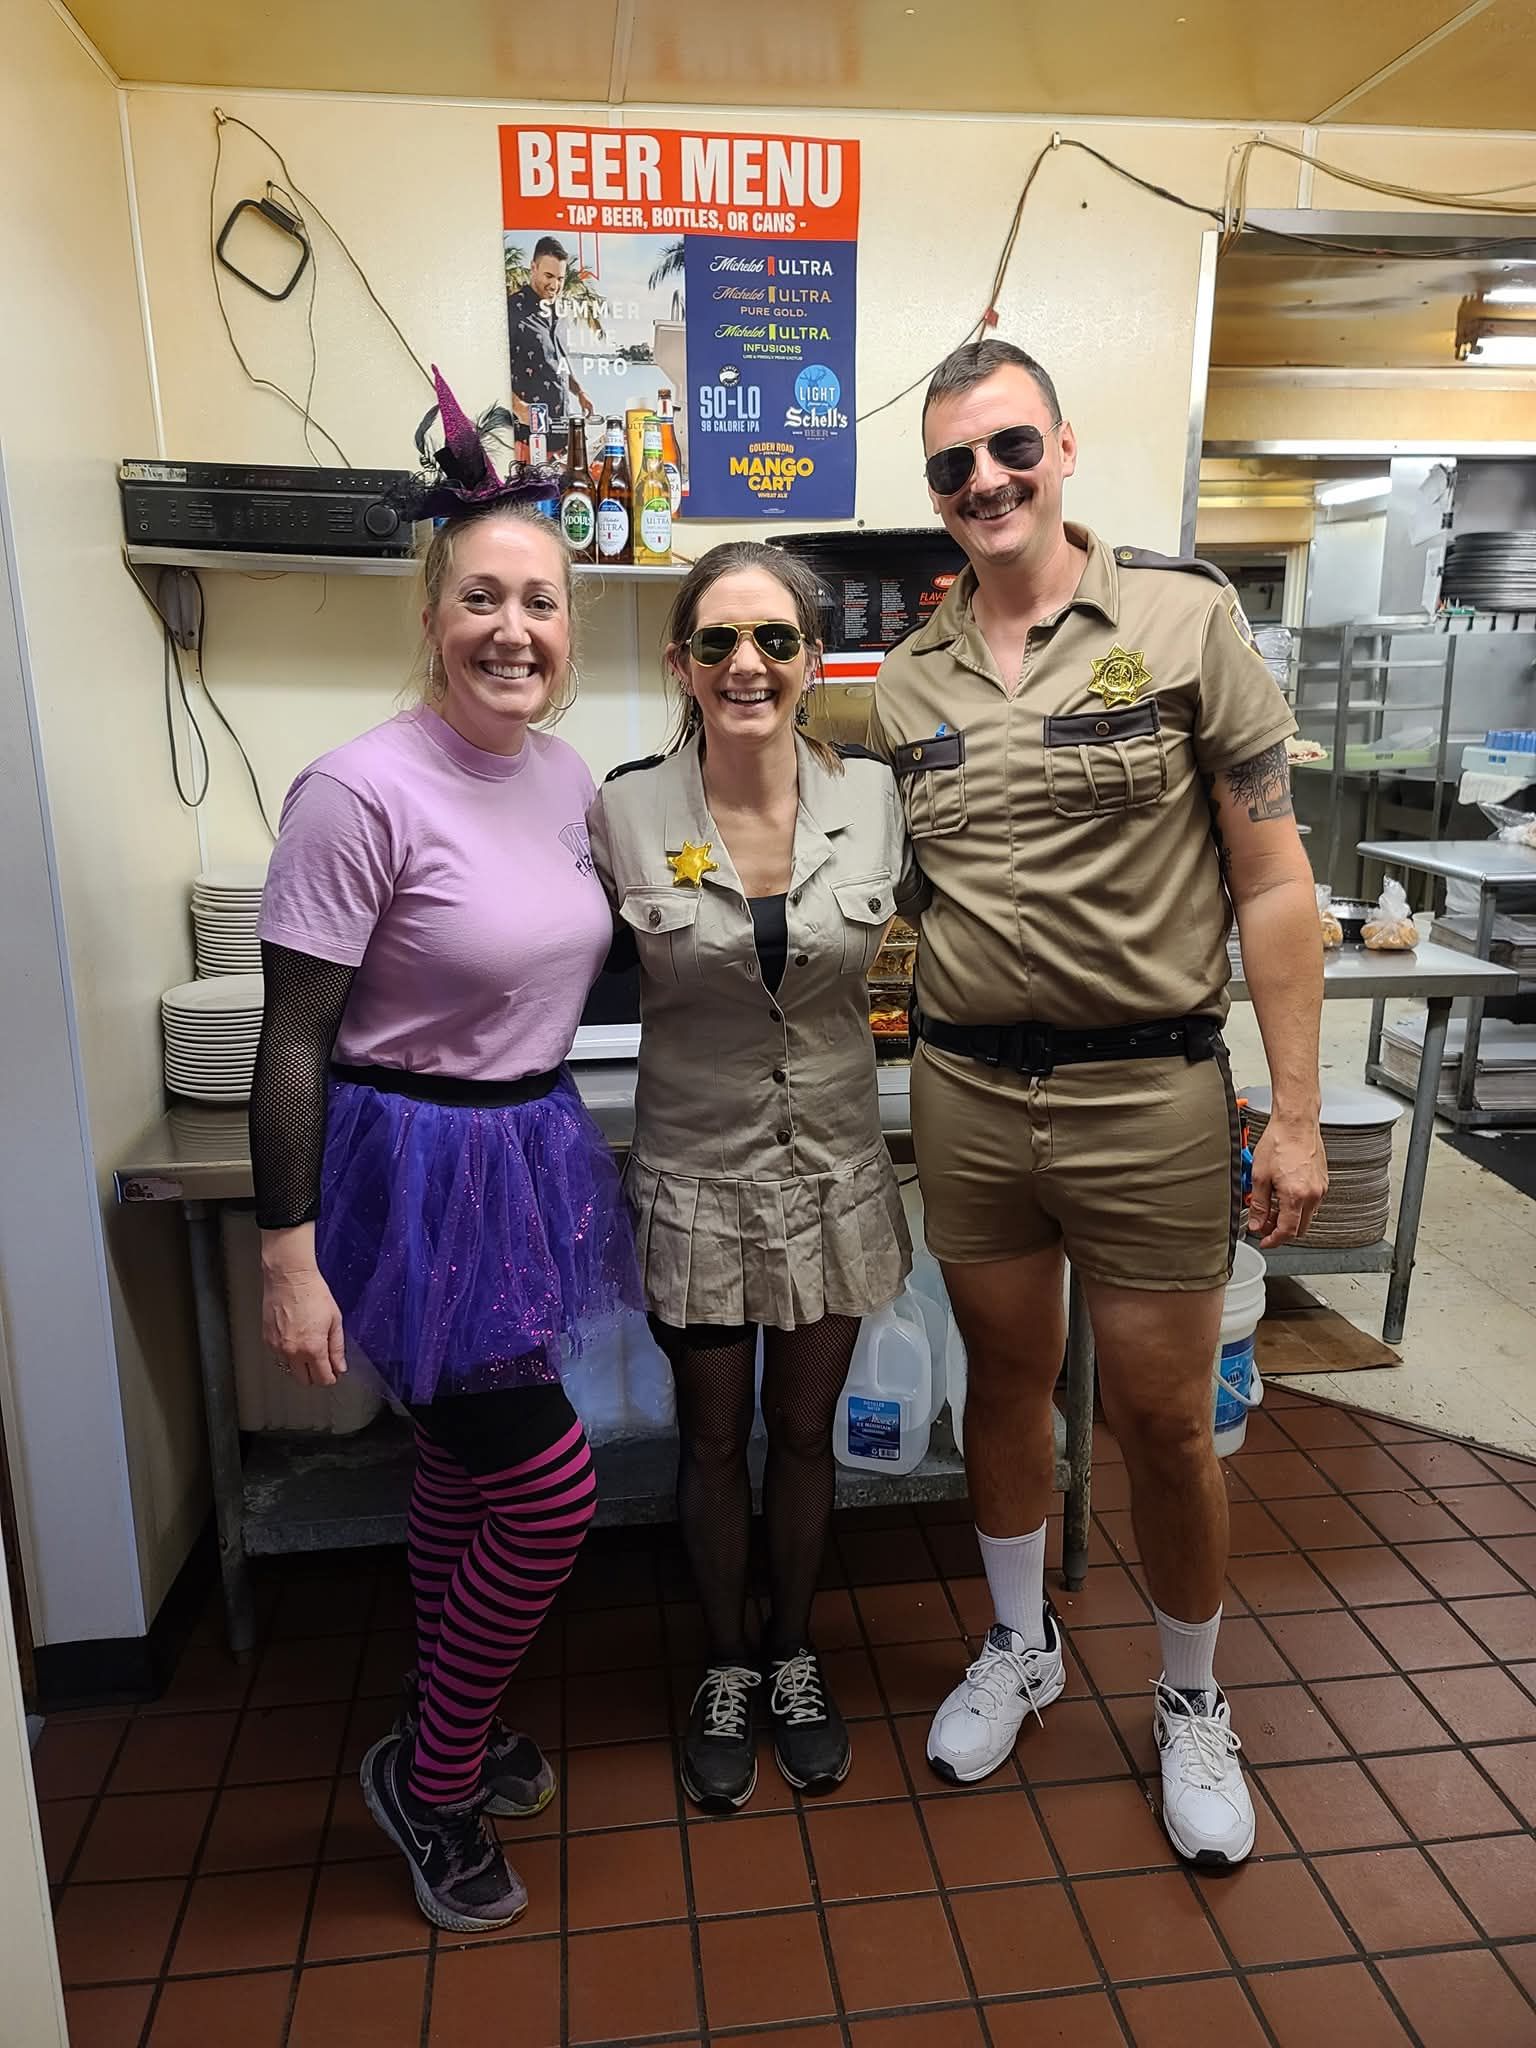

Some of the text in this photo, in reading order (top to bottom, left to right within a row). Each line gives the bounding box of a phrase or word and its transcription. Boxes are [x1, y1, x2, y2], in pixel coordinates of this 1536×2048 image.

[517, 131, 843, 208] BEER MENU
[567, 205, 598, 225] TAP
[601, 206, 648, 229] BEER,
[652, 207, 724, 232] BOTTLES,
[727, 211, 748, 231] OR
[752, 212, 796, 233] CANS
[709, 255, 833, 276] Michelob ULTRA
[712, 286, 832, 303] Michelob ULTRA
[538, 299, 640, 320] SUMMER
[740, 306, 770, 316] PURE
[714, 323, 831, 340] Michelob ULTRA
[743, 343, 802, 354] INFUSIONS
[556, 357, 628, 377] A PRO
[700, 386, 760, 419] SO-LO
[799, 386, 835, 402] LIGHT
[713, 420, 745, 432] CALORIE
[746, 420, 760, 432] IPA
[784, 406, 848, 428] Schell's
[749, 442, 775, 453] GOLDEN
[776, 443, 794, 454] ROAD
[729, 457, 814, 477] MANGO
[748, 476, 795, 491] CART
